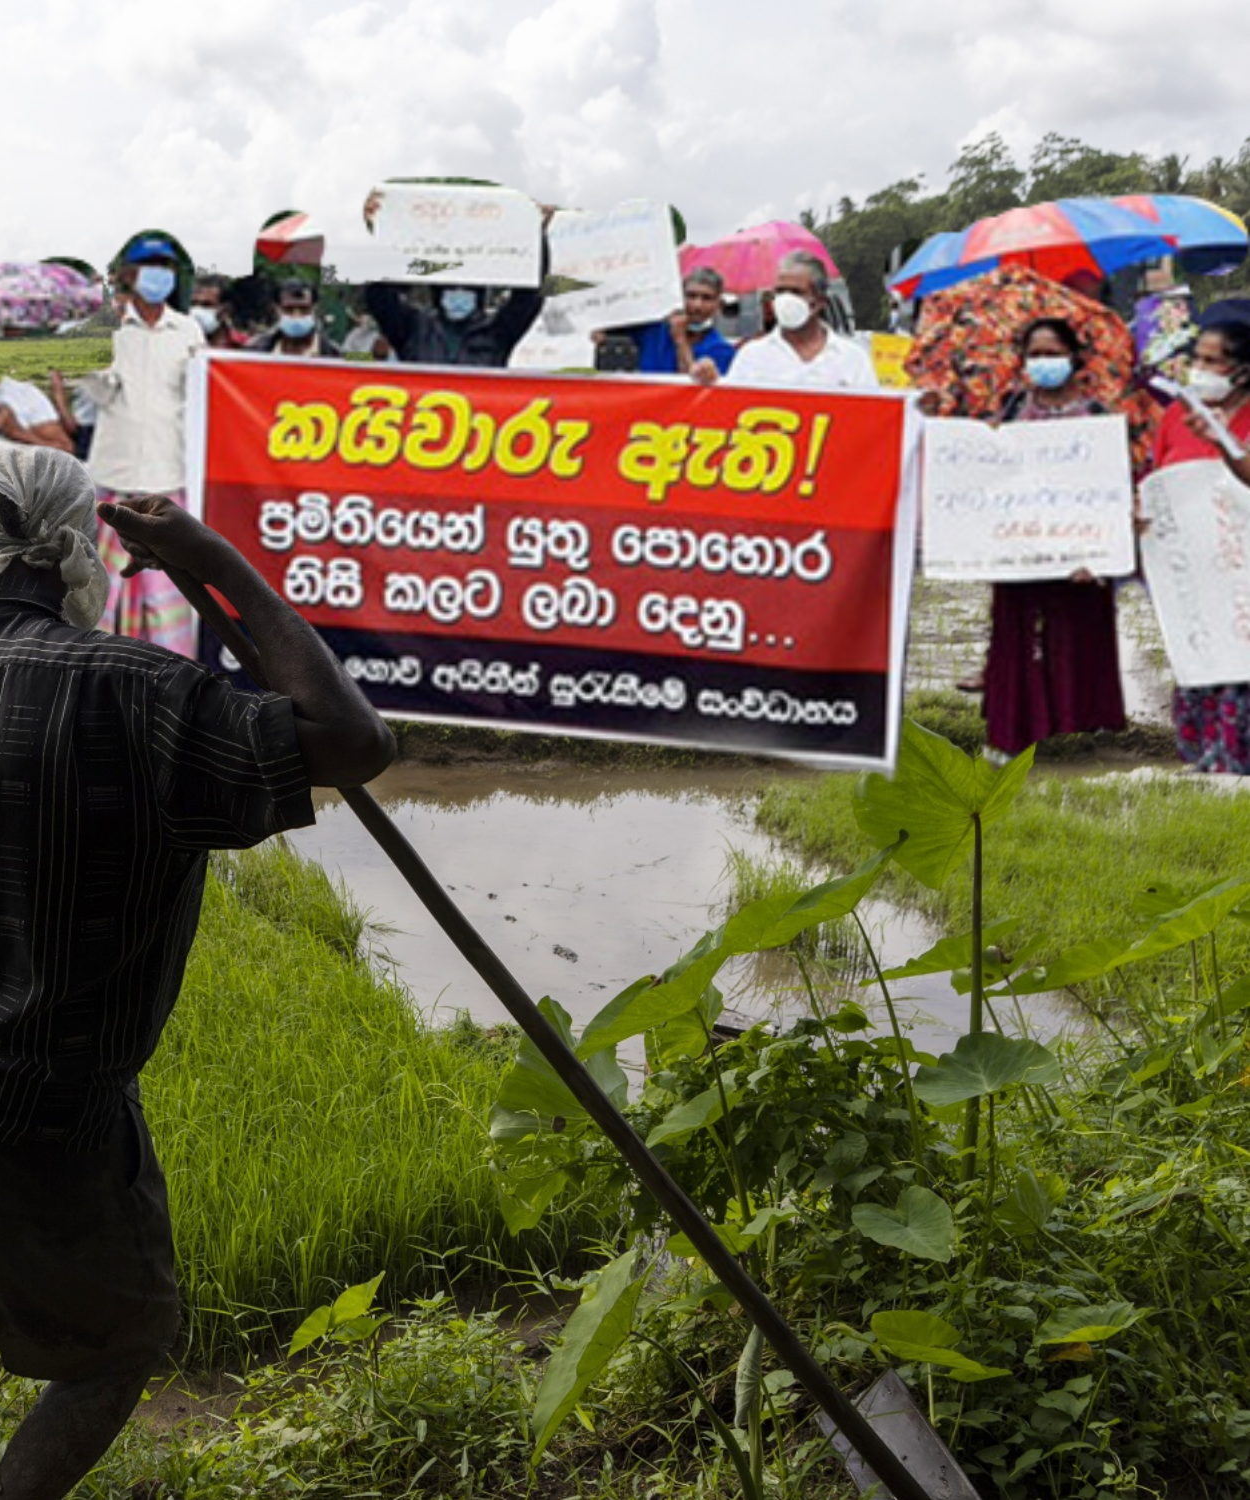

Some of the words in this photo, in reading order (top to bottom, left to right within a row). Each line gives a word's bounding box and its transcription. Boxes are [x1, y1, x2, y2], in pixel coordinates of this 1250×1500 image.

[267, 384, 590, 477] කයිවාරු
[617, 406, 831, 502] ඇති!
[258, 492, 485, 551] ප්‍රමිතියෙන්
[506, 516, 590, 571] යුතු
[611, 524, 833, 581] පොහොර
[283, 554, 364, 608] නිසි
[383, 568, 502, 622] කලට
[521, 575, 617, 630] ලබා
[697, 686, 859, 726] සංවිධානය
